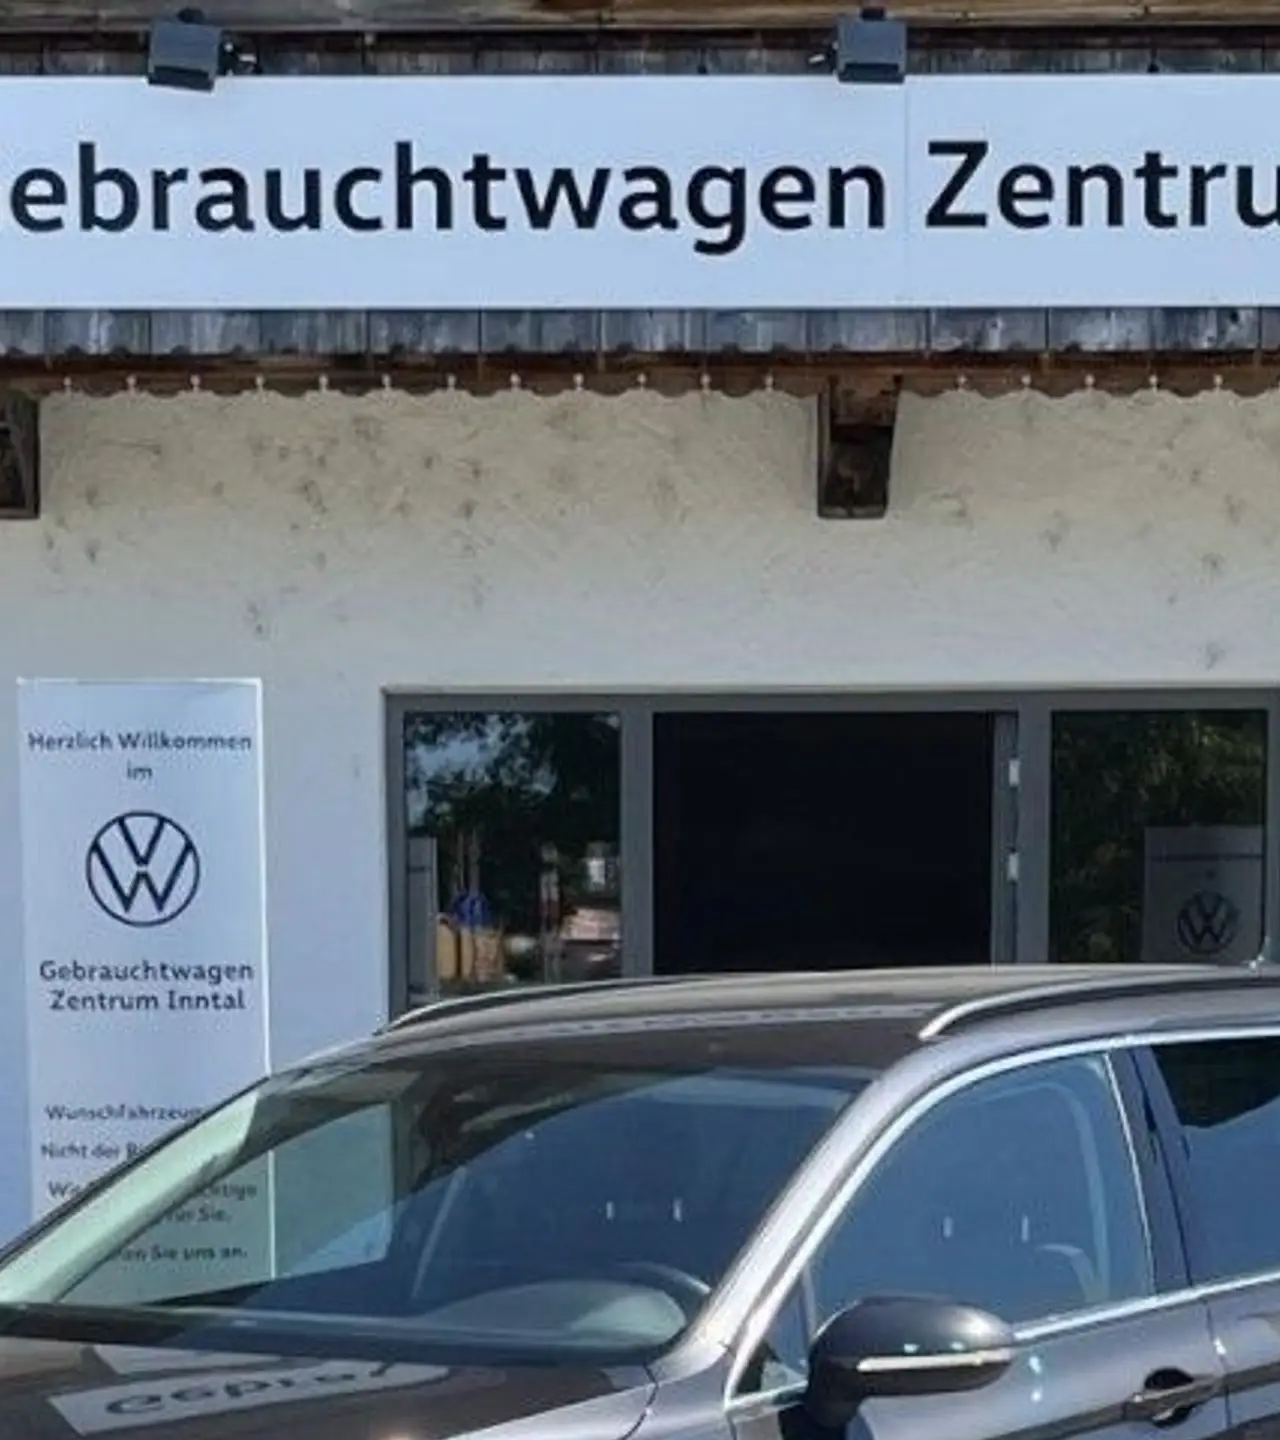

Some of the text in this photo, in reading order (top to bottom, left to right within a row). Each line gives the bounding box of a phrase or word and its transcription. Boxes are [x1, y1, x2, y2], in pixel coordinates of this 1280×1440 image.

[28, 731, 252, 750] Herzlich Willkommen
[126, 762, 153, 780] im
[39, 959, 254, 985] Gebrauchtwagen
[50, 988, 245, 1011] Zentrum Inntal
